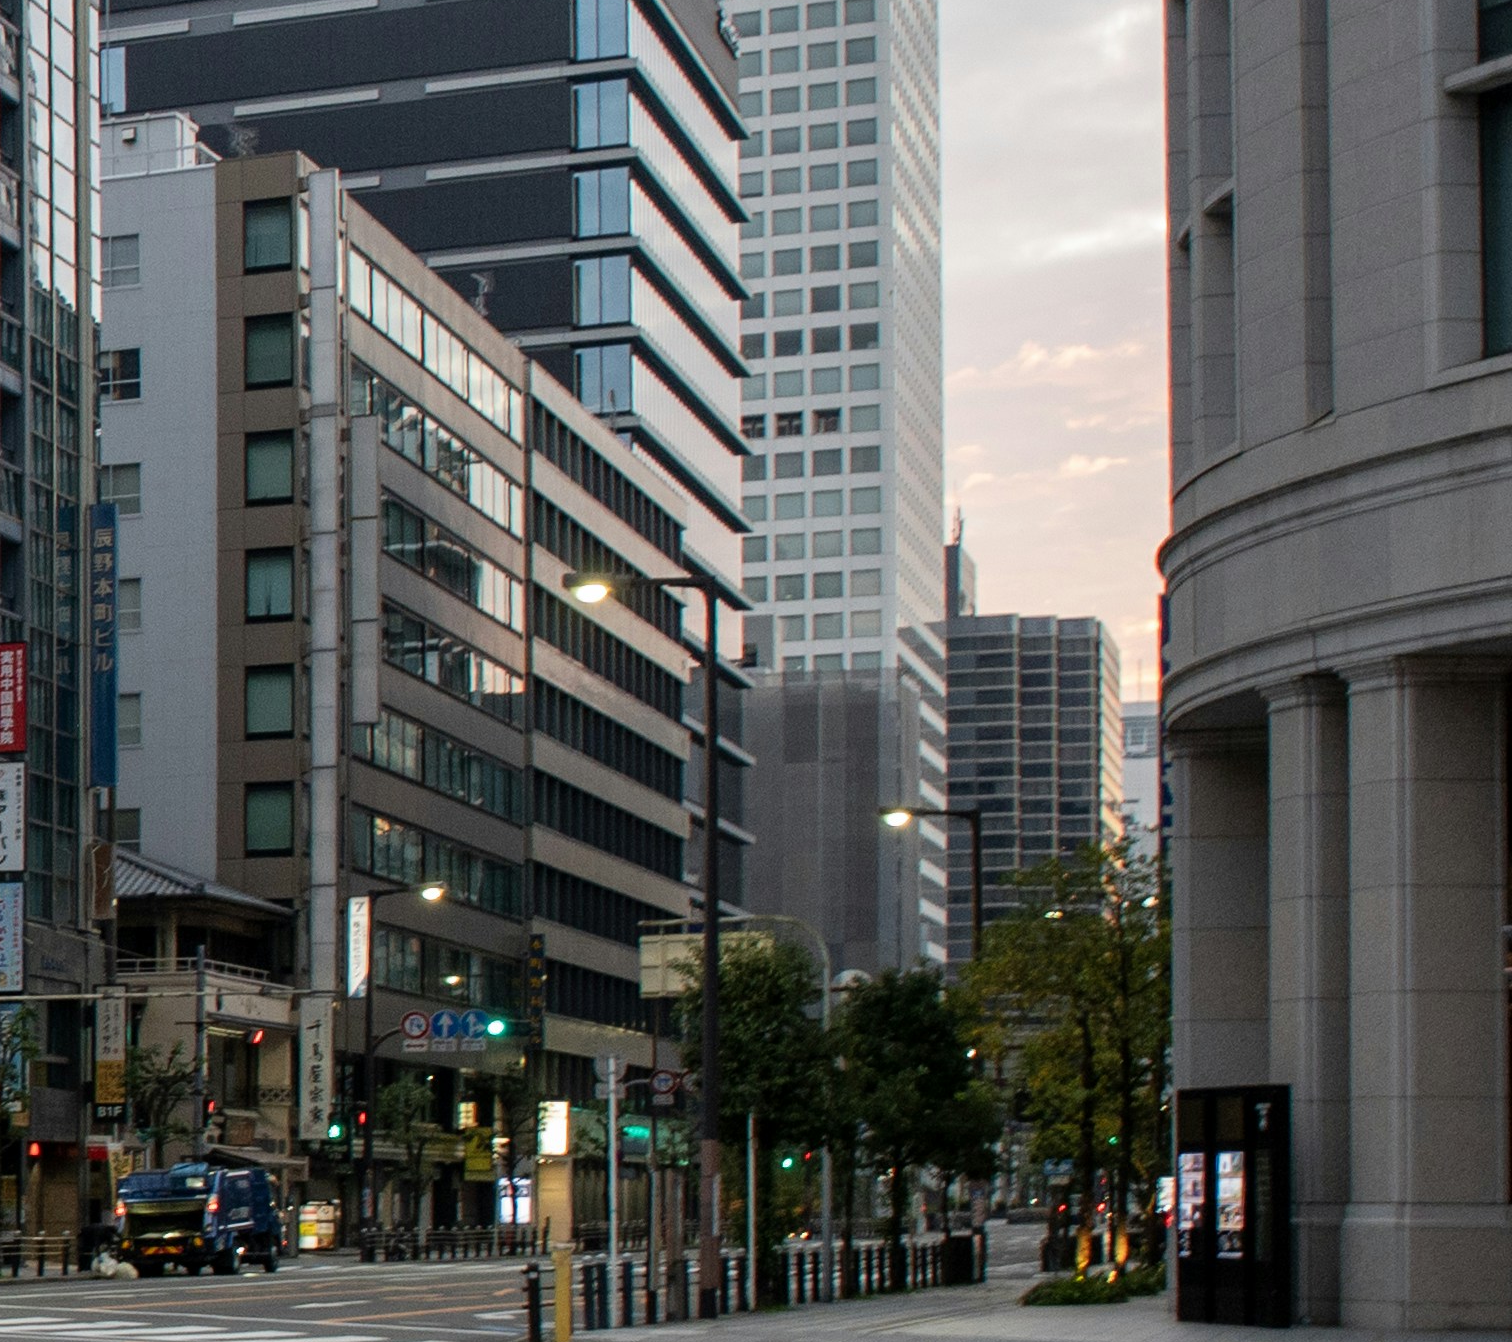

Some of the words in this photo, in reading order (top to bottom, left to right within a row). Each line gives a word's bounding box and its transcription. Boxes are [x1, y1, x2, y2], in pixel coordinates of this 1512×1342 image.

[92, 528, 113, 672] 辰野本町ビル
[97, 1106, 123, 1118] B1F
